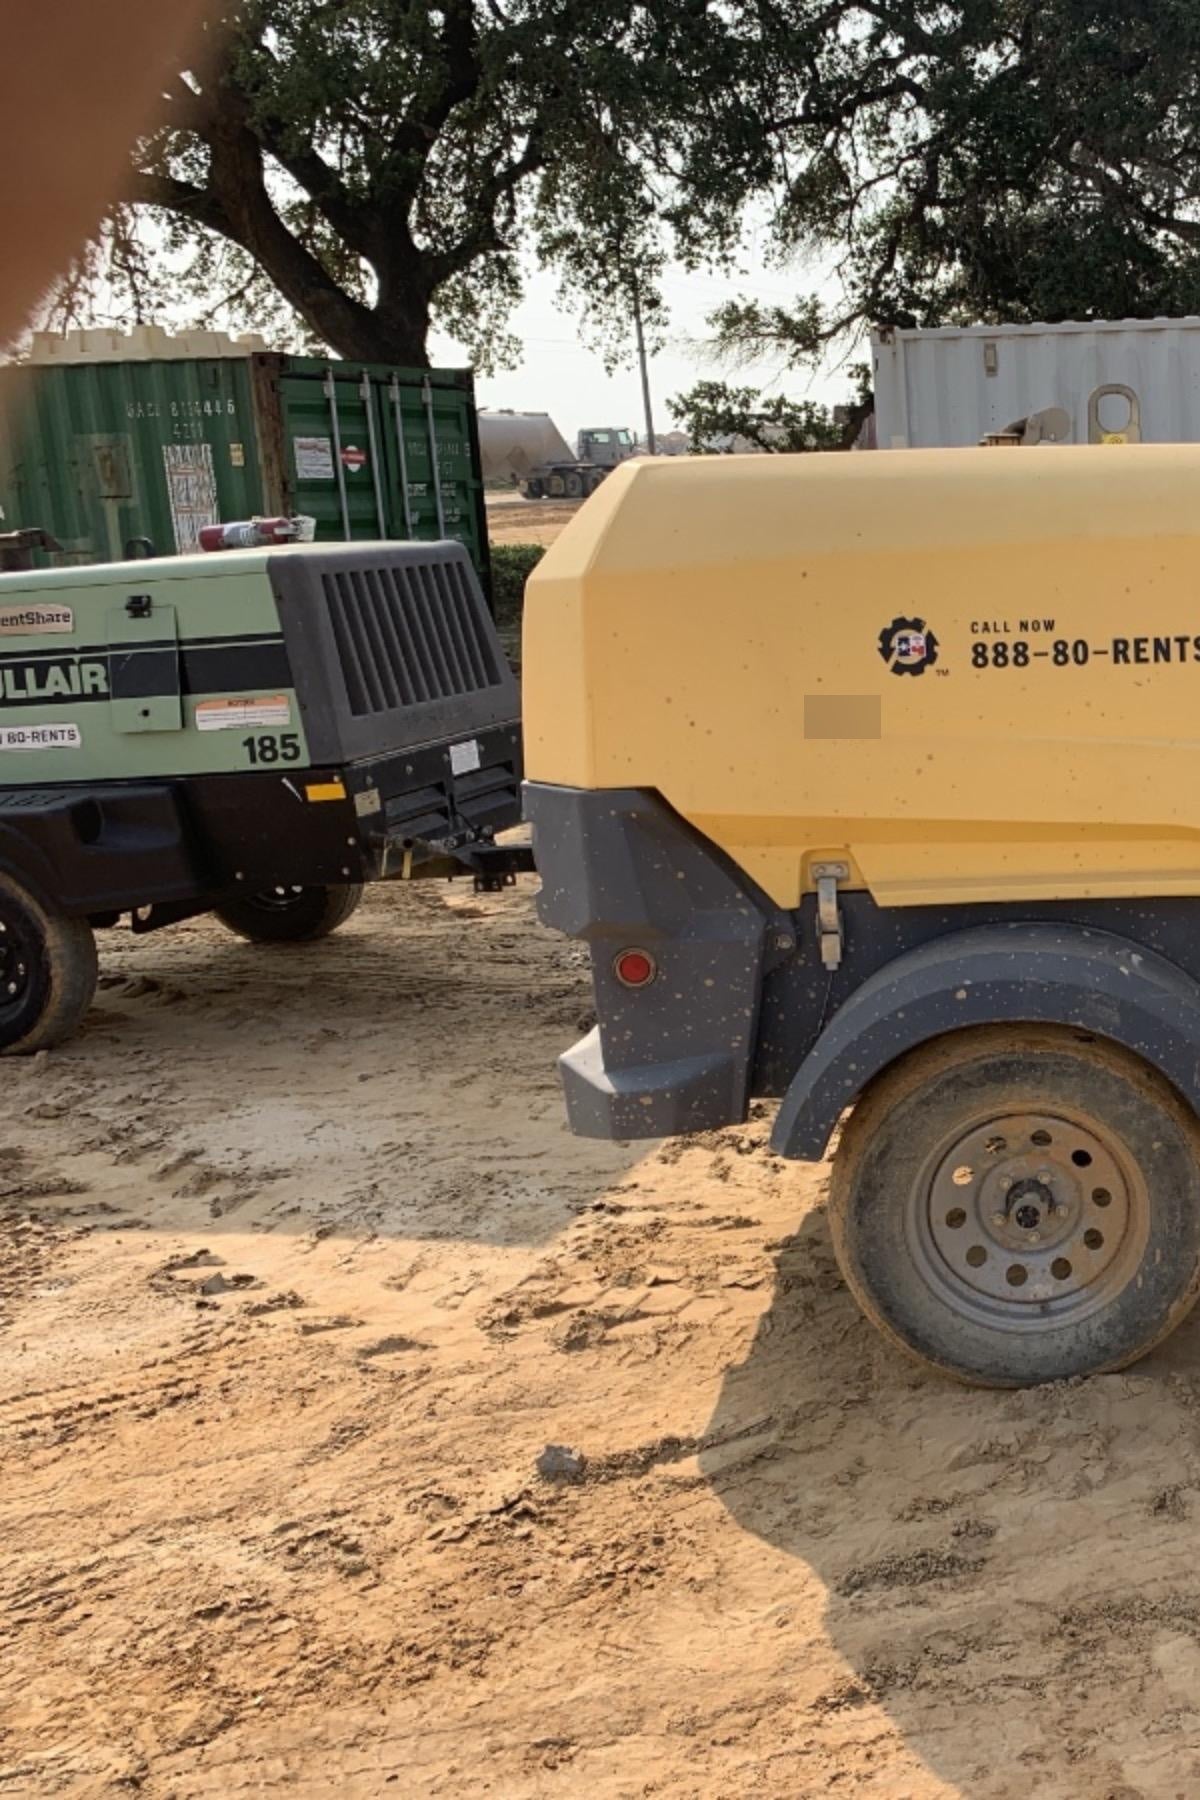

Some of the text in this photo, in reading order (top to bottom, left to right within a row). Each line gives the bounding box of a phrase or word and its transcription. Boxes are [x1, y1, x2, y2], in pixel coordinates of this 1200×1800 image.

[971, 620, 1055, 634] CALL NOW
[0, 663, 109, 699] LLAIR
[243, 733, 300, 764] 185
